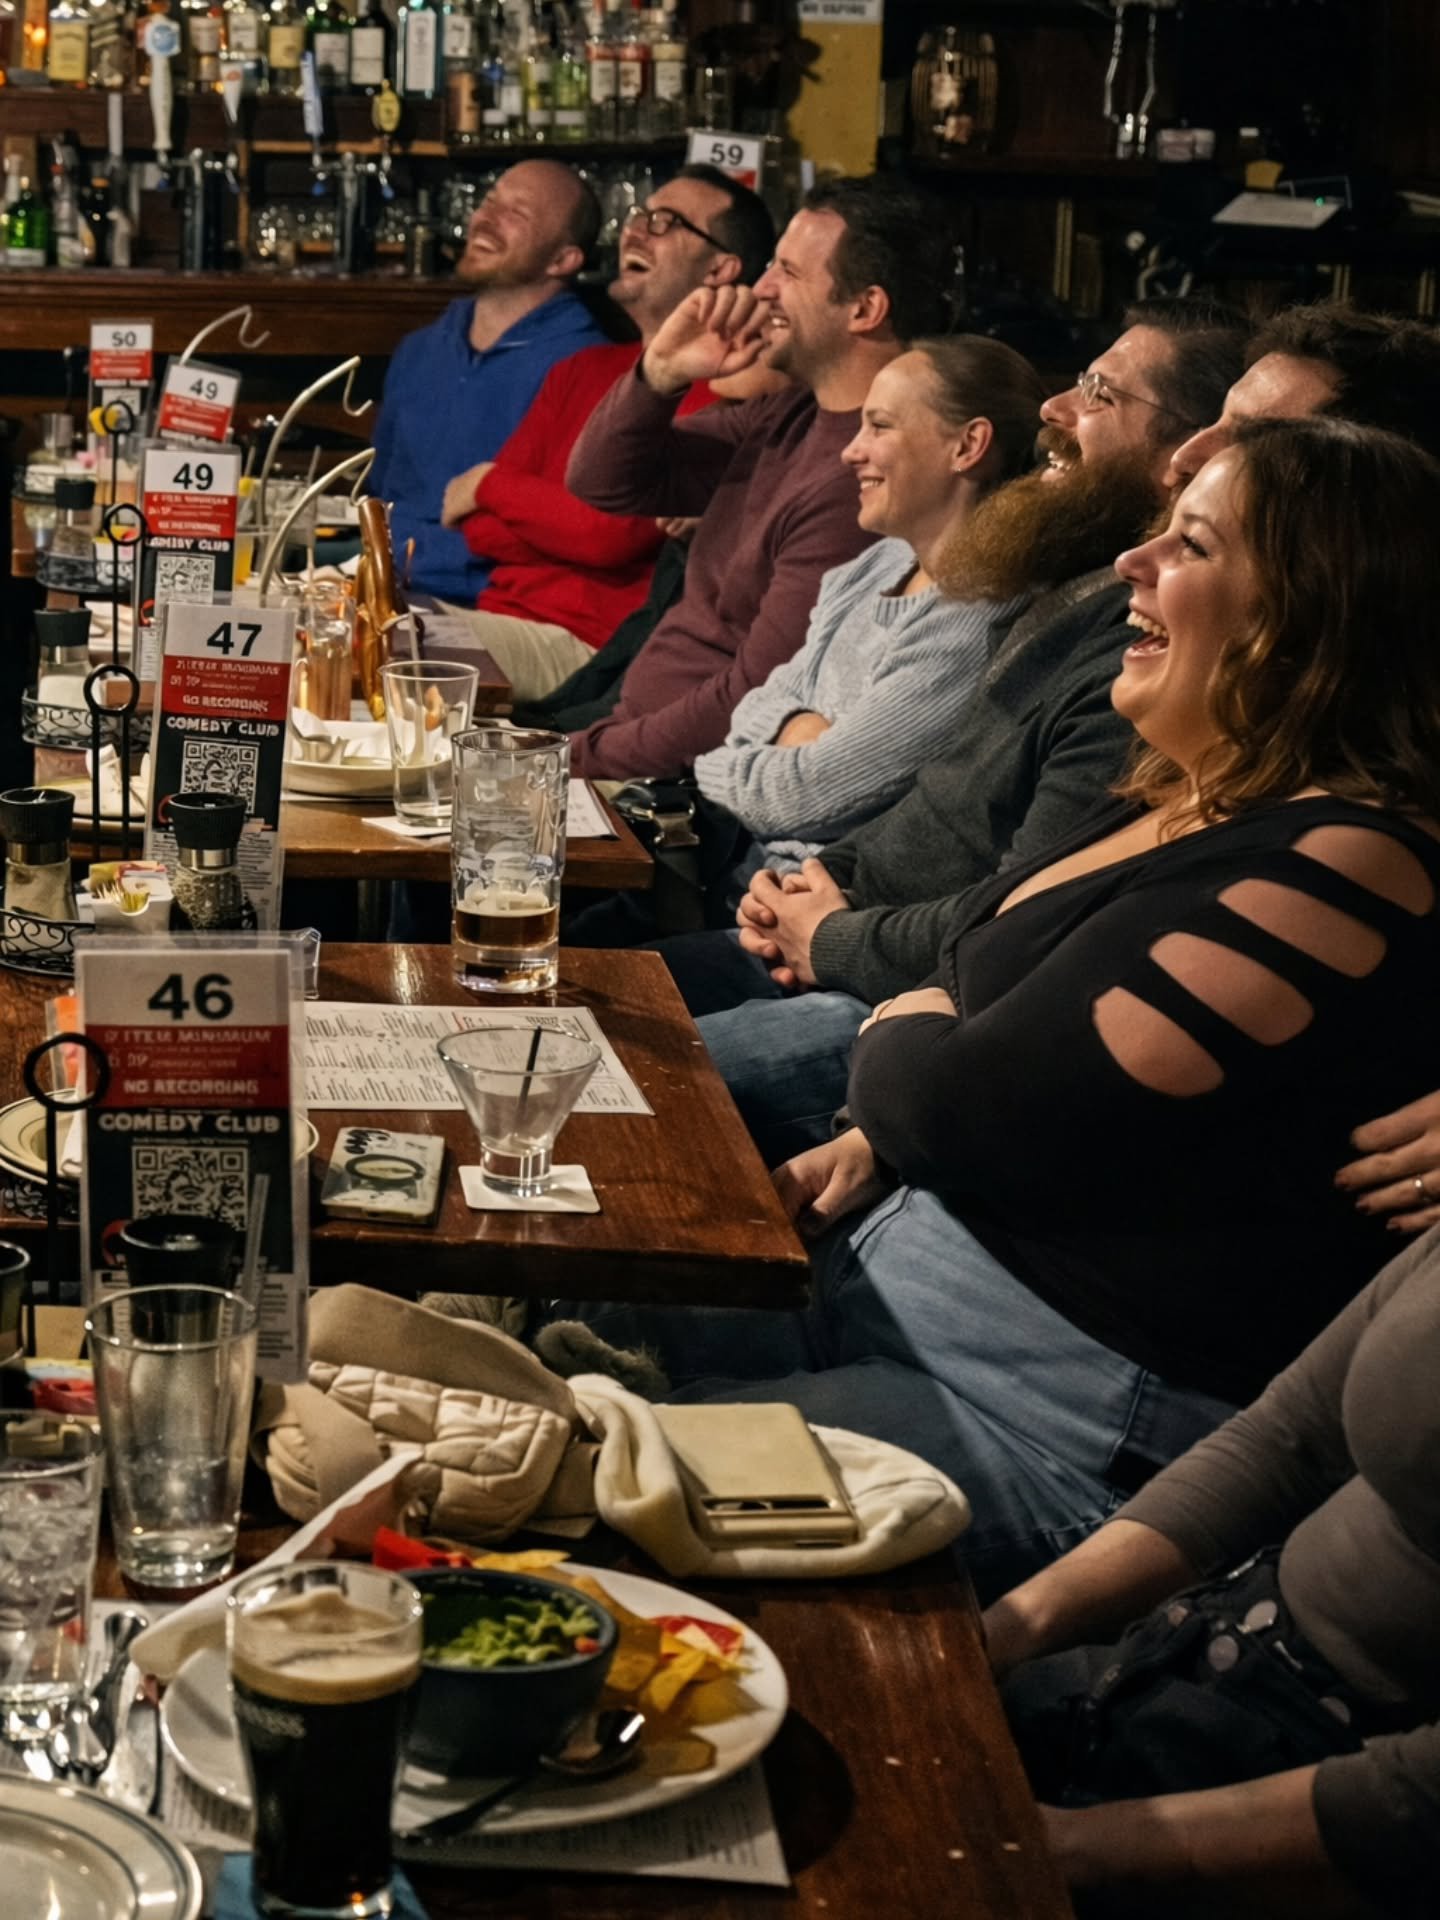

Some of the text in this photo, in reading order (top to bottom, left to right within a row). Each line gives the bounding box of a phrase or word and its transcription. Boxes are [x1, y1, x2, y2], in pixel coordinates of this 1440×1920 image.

[709, 142, 745, 166] 59
[111, 330, 138, 347] 50
[189, 378, 219, 400] 49
[172, 461, 214, 491] 49
[206, 621, 263, 657] 47
[166, 716, 232, 734] COMEDY
[147, 972, 234, 1020] 46
[123, 1079, 260, 1095] NO RECORDING
[99, 1112, 281, 1133] COMEDY CLUB
